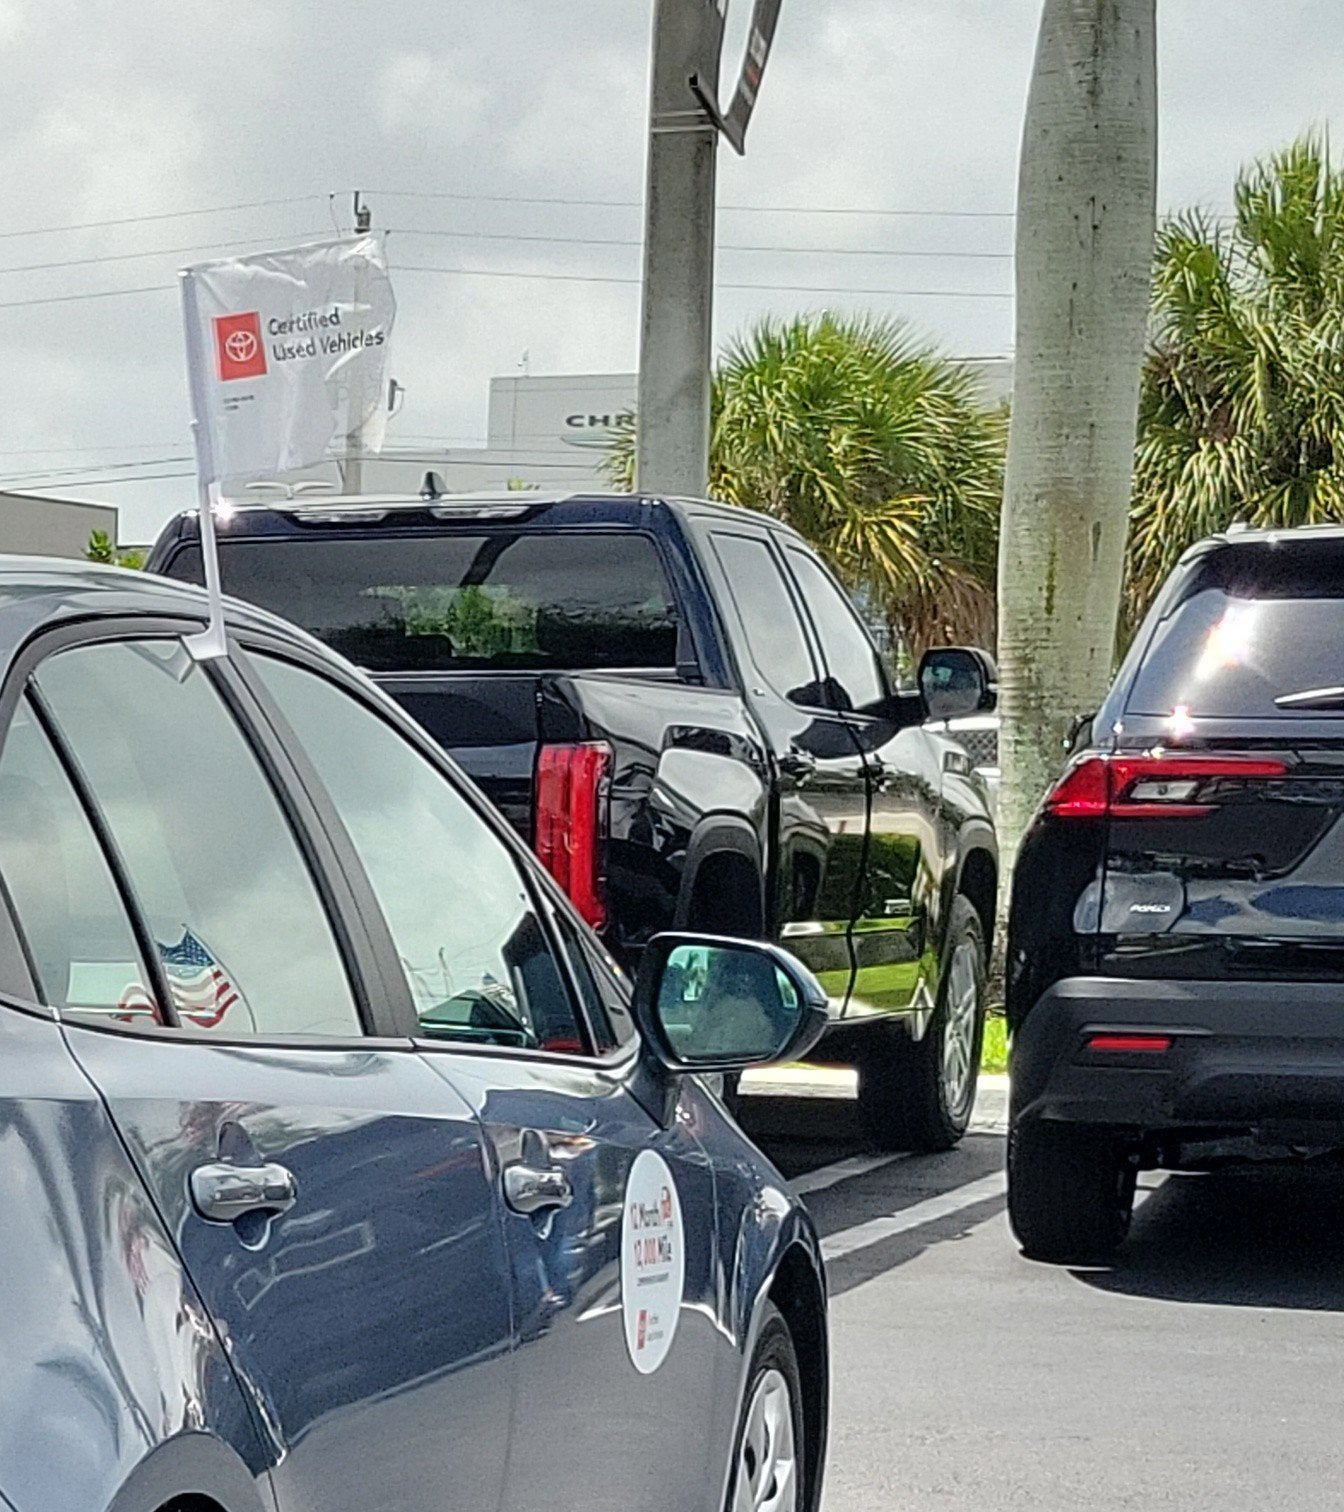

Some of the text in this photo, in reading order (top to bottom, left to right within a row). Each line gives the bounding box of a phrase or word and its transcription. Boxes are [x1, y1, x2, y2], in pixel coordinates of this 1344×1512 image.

[268, 307, 341, 335] Certified
[273, 329, 385, 361] Used Vehicles
[565, 414, 635, 428] CHR
